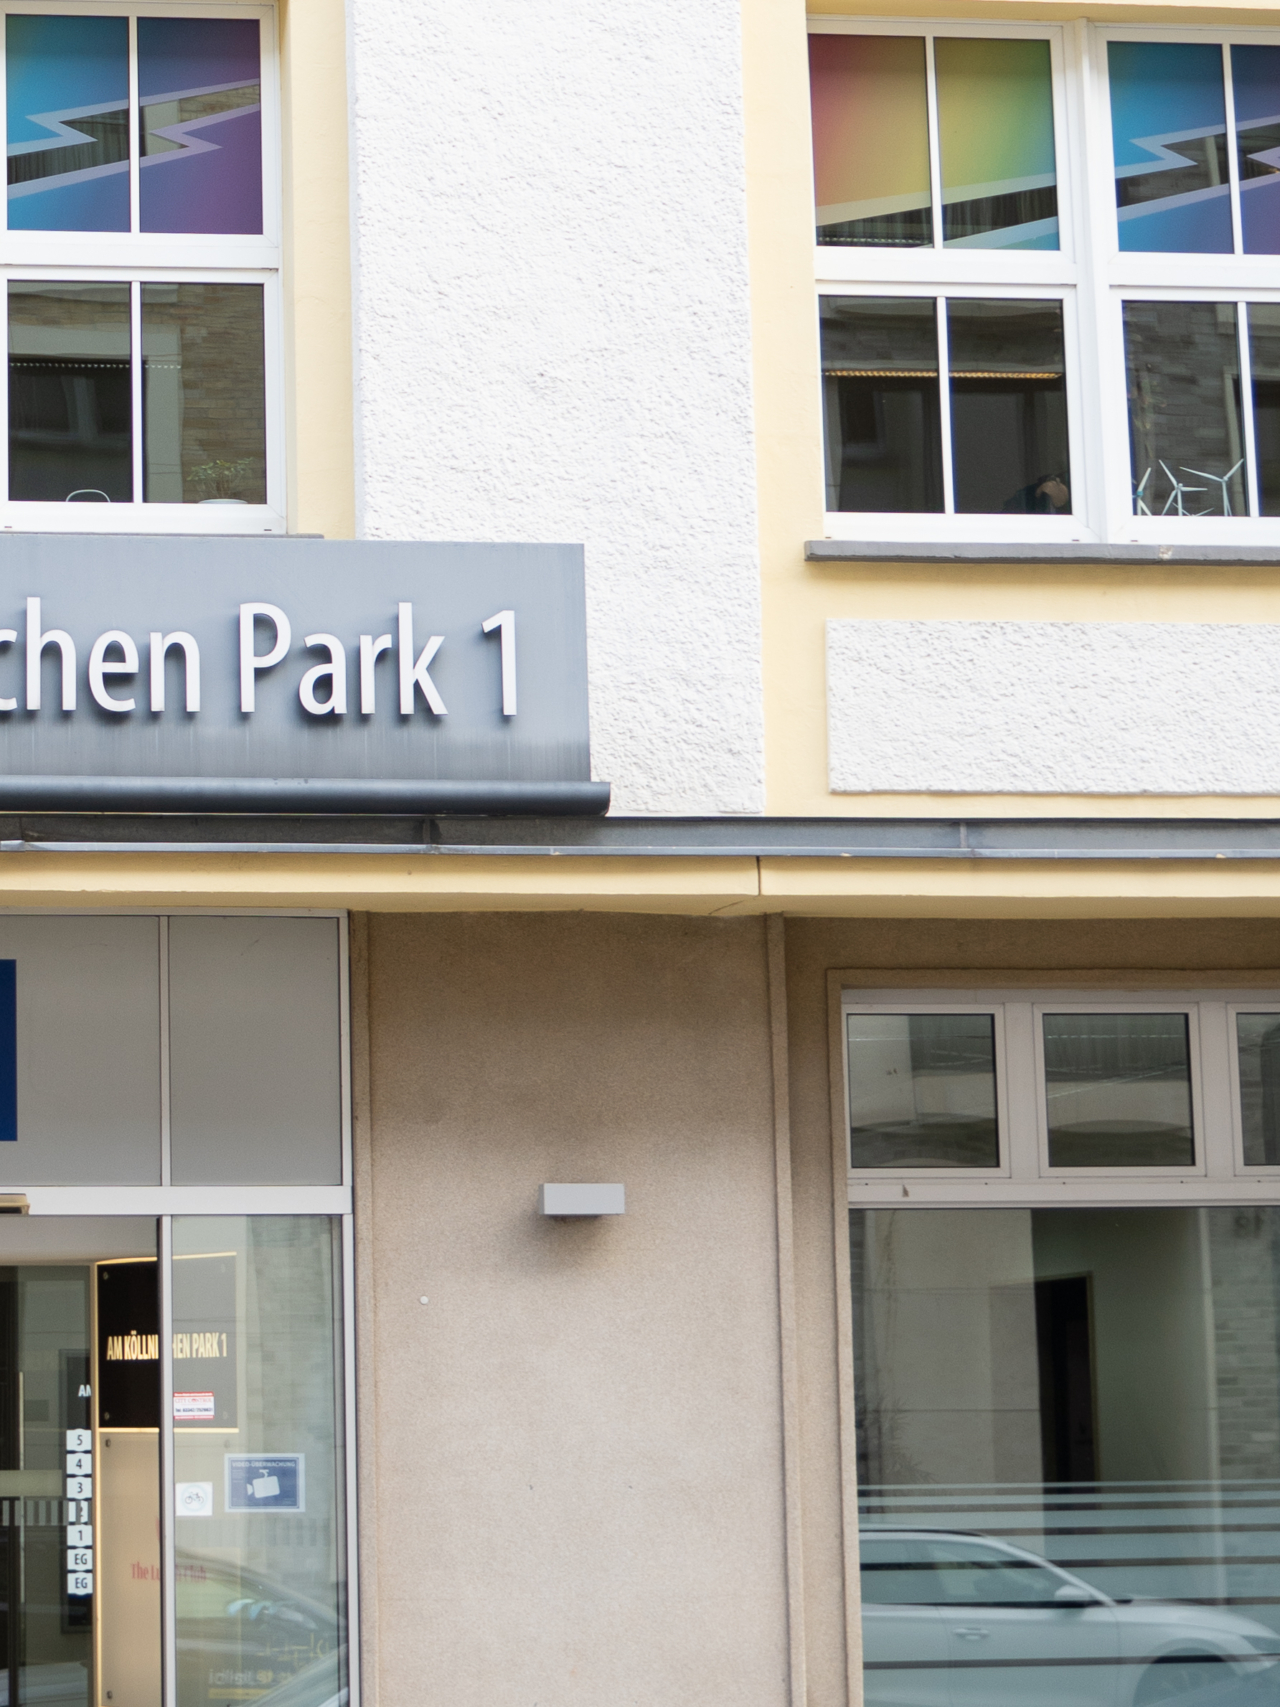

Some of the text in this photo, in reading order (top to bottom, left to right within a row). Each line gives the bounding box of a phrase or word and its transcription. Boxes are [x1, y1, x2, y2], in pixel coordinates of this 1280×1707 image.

[239, 602, 448, 715] Park
[482, 609, 518, 716] 1
[106, 1335, 122, 1360] AM
[192, 1332, 220, 1358] PARK
[221, 1332, 227, 1357] 1
[77, 1434, 83, 1446] 5
[75, 1458, 83, 1470] 4
[231, 1460, 296, 1468] VIDEO-ÜBERWACHUNG
[77, 1482, 83, 1494] 3
[78, 1529, 83, 1542] 1
[74, 1553, 88, 1566] EG
[131, 1561, 149, 1581] The
[74, 1577, 88, 1589] EG
